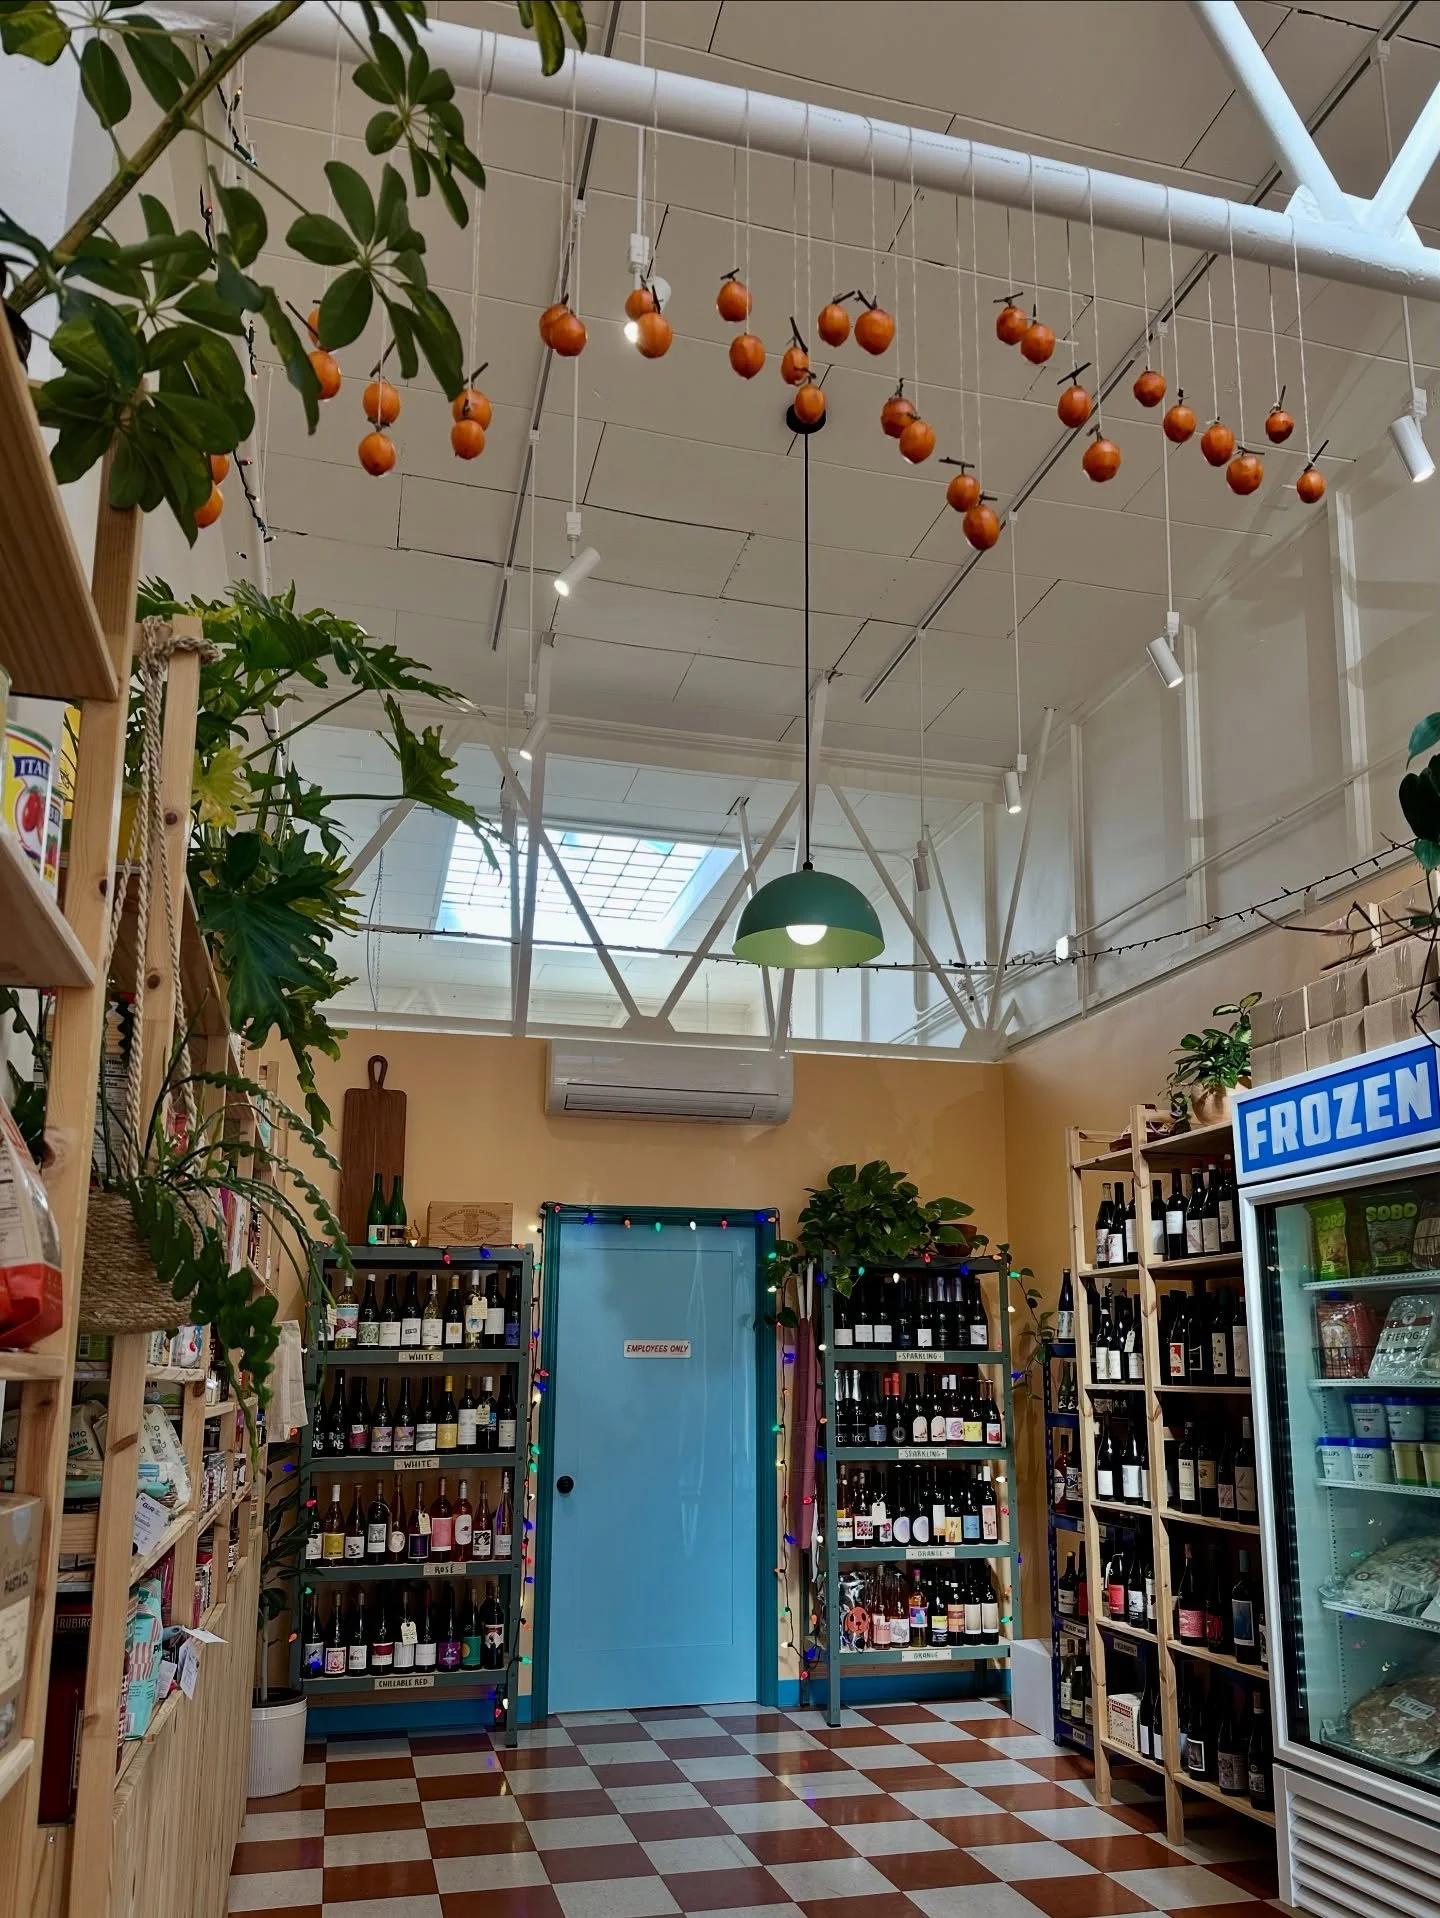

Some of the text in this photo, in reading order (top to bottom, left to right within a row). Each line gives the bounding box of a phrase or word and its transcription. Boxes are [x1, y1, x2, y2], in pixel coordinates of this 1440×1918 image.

[1245, 1062, 1432, 1161] FROZEN
[626, 1344, 688, 1353] EMPLOYEES ONLY
[408, 1353, 434, 1361] WHITE
[902, 1352, 938, 1360] SPARKLING
[904, 1450, 940, 1458] SPARKLING
[403, 1460, 432, 1469] WHITE
[434, 1564, 455, 1574] ROSÉ
[913, 1651, 939, 1659] ORANGE
[378, 1678, 428, 1688] CHILLABLE RED
